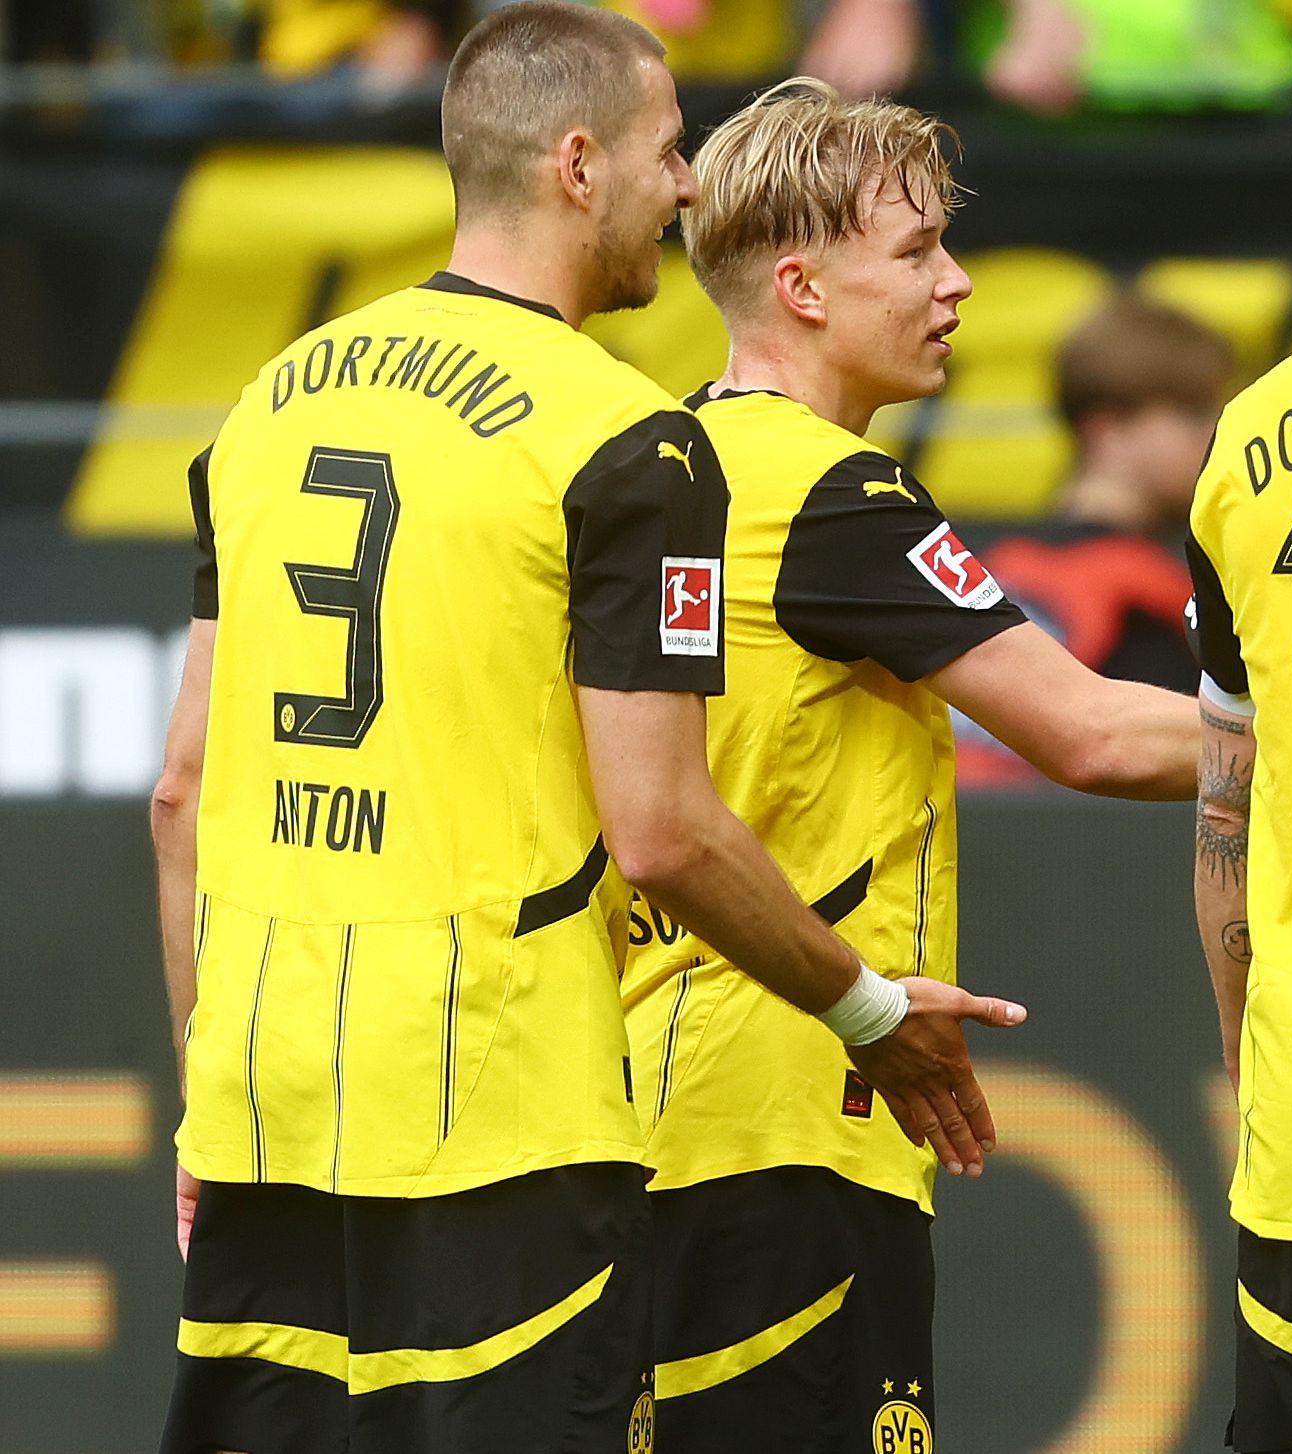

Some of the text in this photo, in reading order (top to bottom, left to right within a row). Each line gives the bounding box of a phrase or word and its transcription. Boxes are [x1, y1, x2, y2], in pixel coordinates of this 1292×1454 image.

[272, 336, 535, 437] DORTMUND
[274, 446, 401, 749] 3
[272, 780, 387, 854] ANTON
[632, 1400, 652, 1450] BVB
[881, 1411, 924, 1454] BVB
